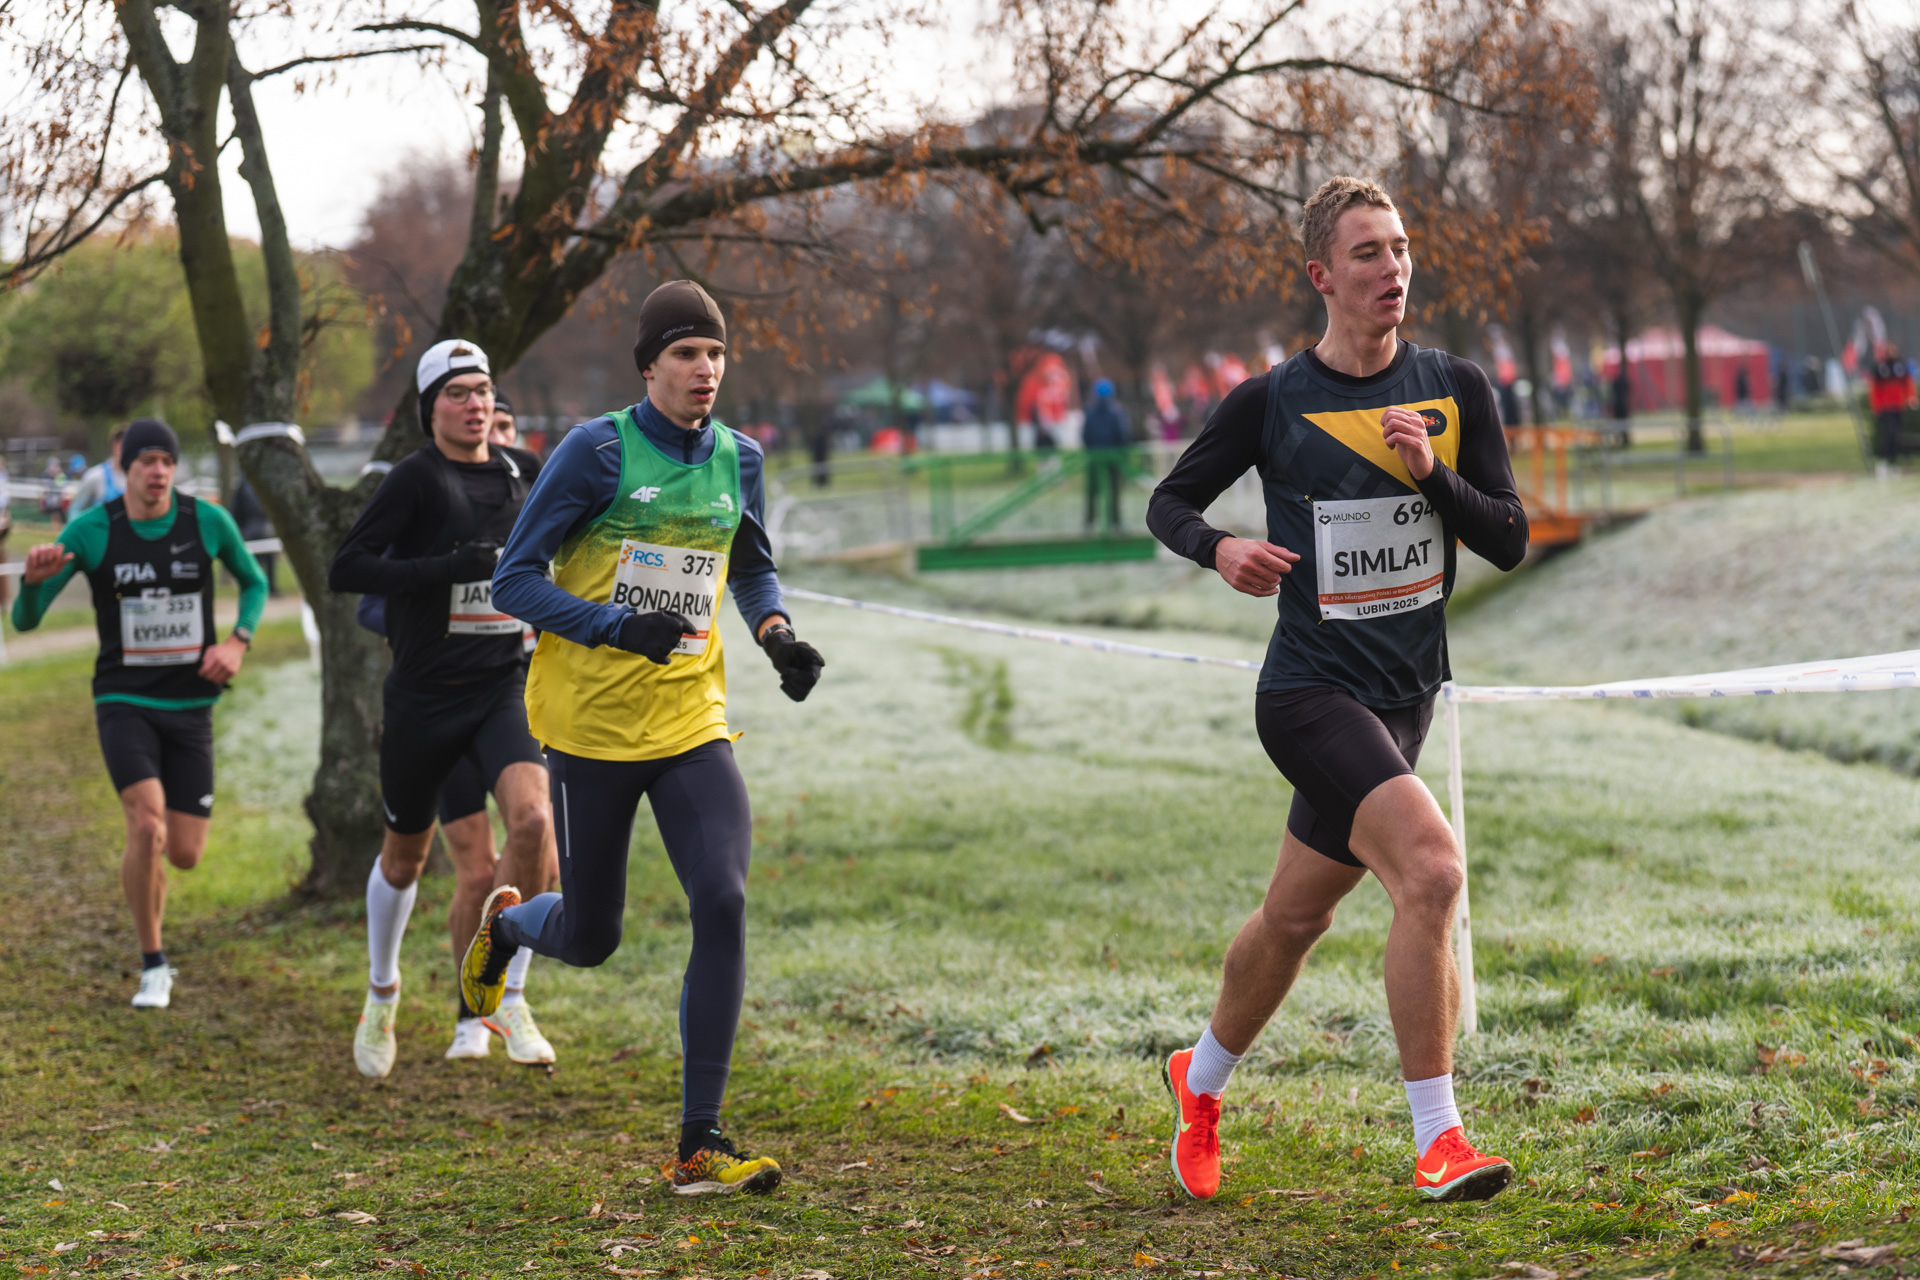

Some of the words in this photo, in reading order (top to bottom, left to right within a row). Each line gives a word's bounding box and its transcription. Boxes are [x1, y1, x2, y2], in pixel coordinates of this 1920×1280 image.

[631, 487, 661, 503] 4F
[1333, 511, 1371, 522] MUNDO
[1393, 501, 1434, 526] 694
[682, 555, 715, 576] 375
[1334, 538, 1432, 577] SIMLAT
[613, 582, 713, 617] BONDARUK
[1376, 589, 1392, 598] Polski
[1357, 602, 1390, 616] LUBIN
[1392, 597, 1419, 611] 2025
